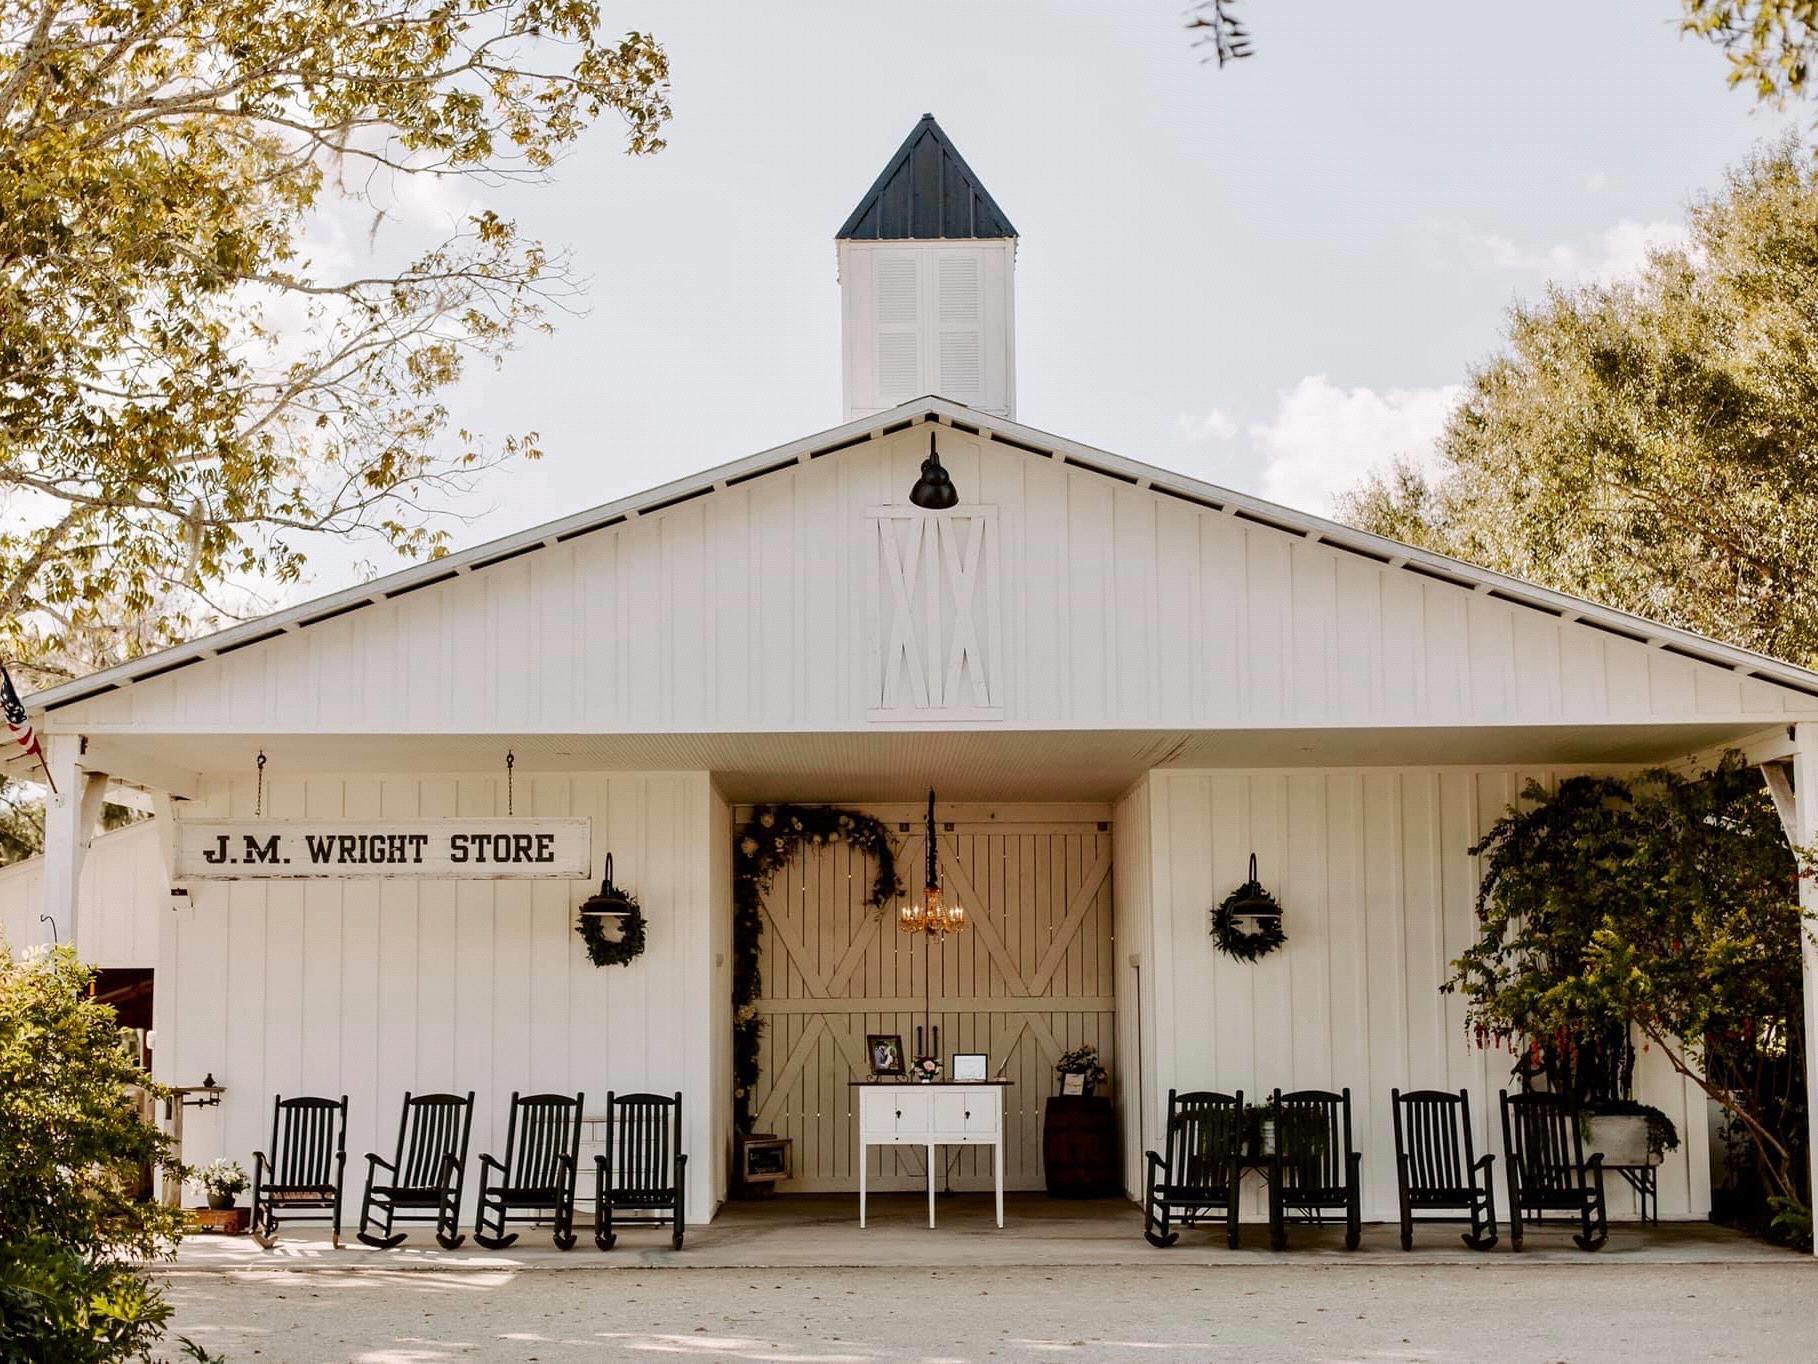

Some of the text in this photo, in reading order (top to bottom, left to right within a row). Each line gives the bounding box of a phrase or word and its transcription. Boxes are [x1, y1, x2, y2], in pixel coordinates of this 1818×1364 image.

[202, 833, 555, 865] J.M. WRIGHT STORE
